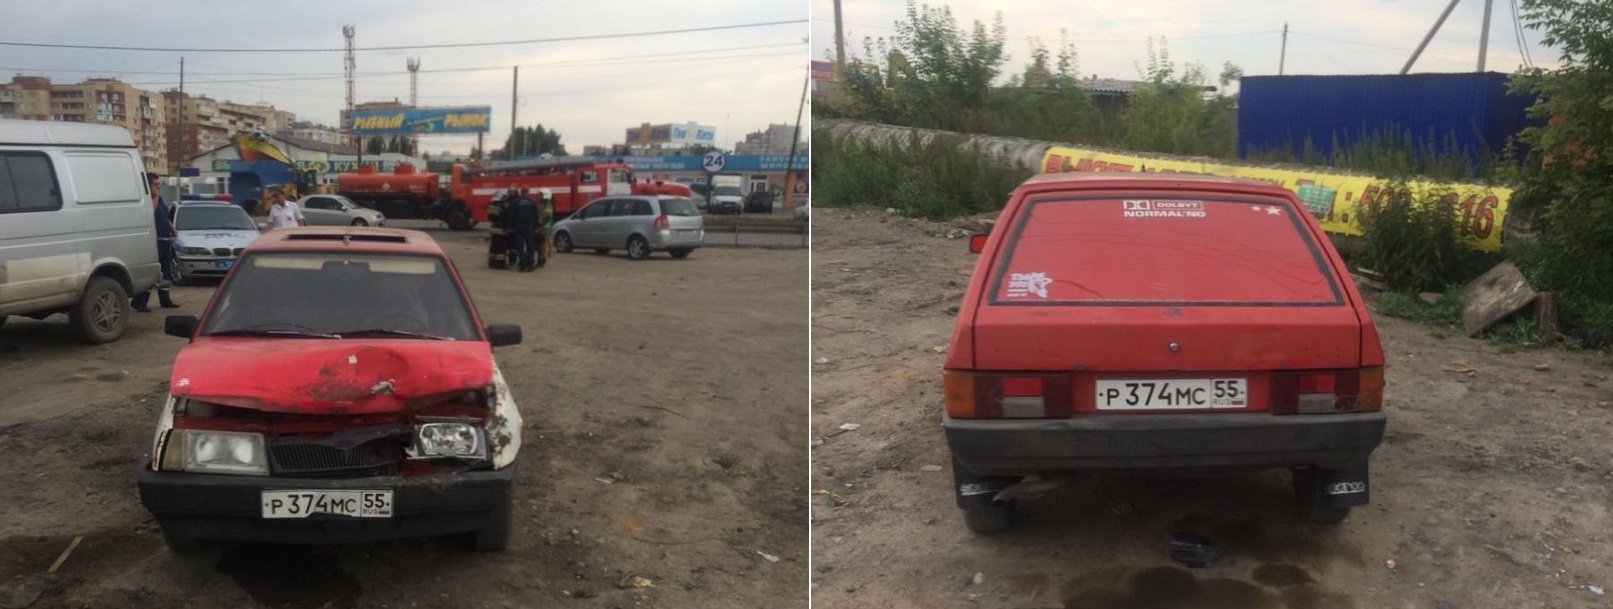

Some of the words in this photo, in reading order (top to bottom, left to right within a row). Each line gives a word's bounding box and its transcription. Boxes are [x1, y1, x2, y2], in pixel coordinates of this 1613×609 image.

[353, 113, 404, 130] РЫБНЫЙ
[705, 155, 723, 168] 24
[1214, 380, 1239, 398] 55
[364, 493, 385, 508] 55
